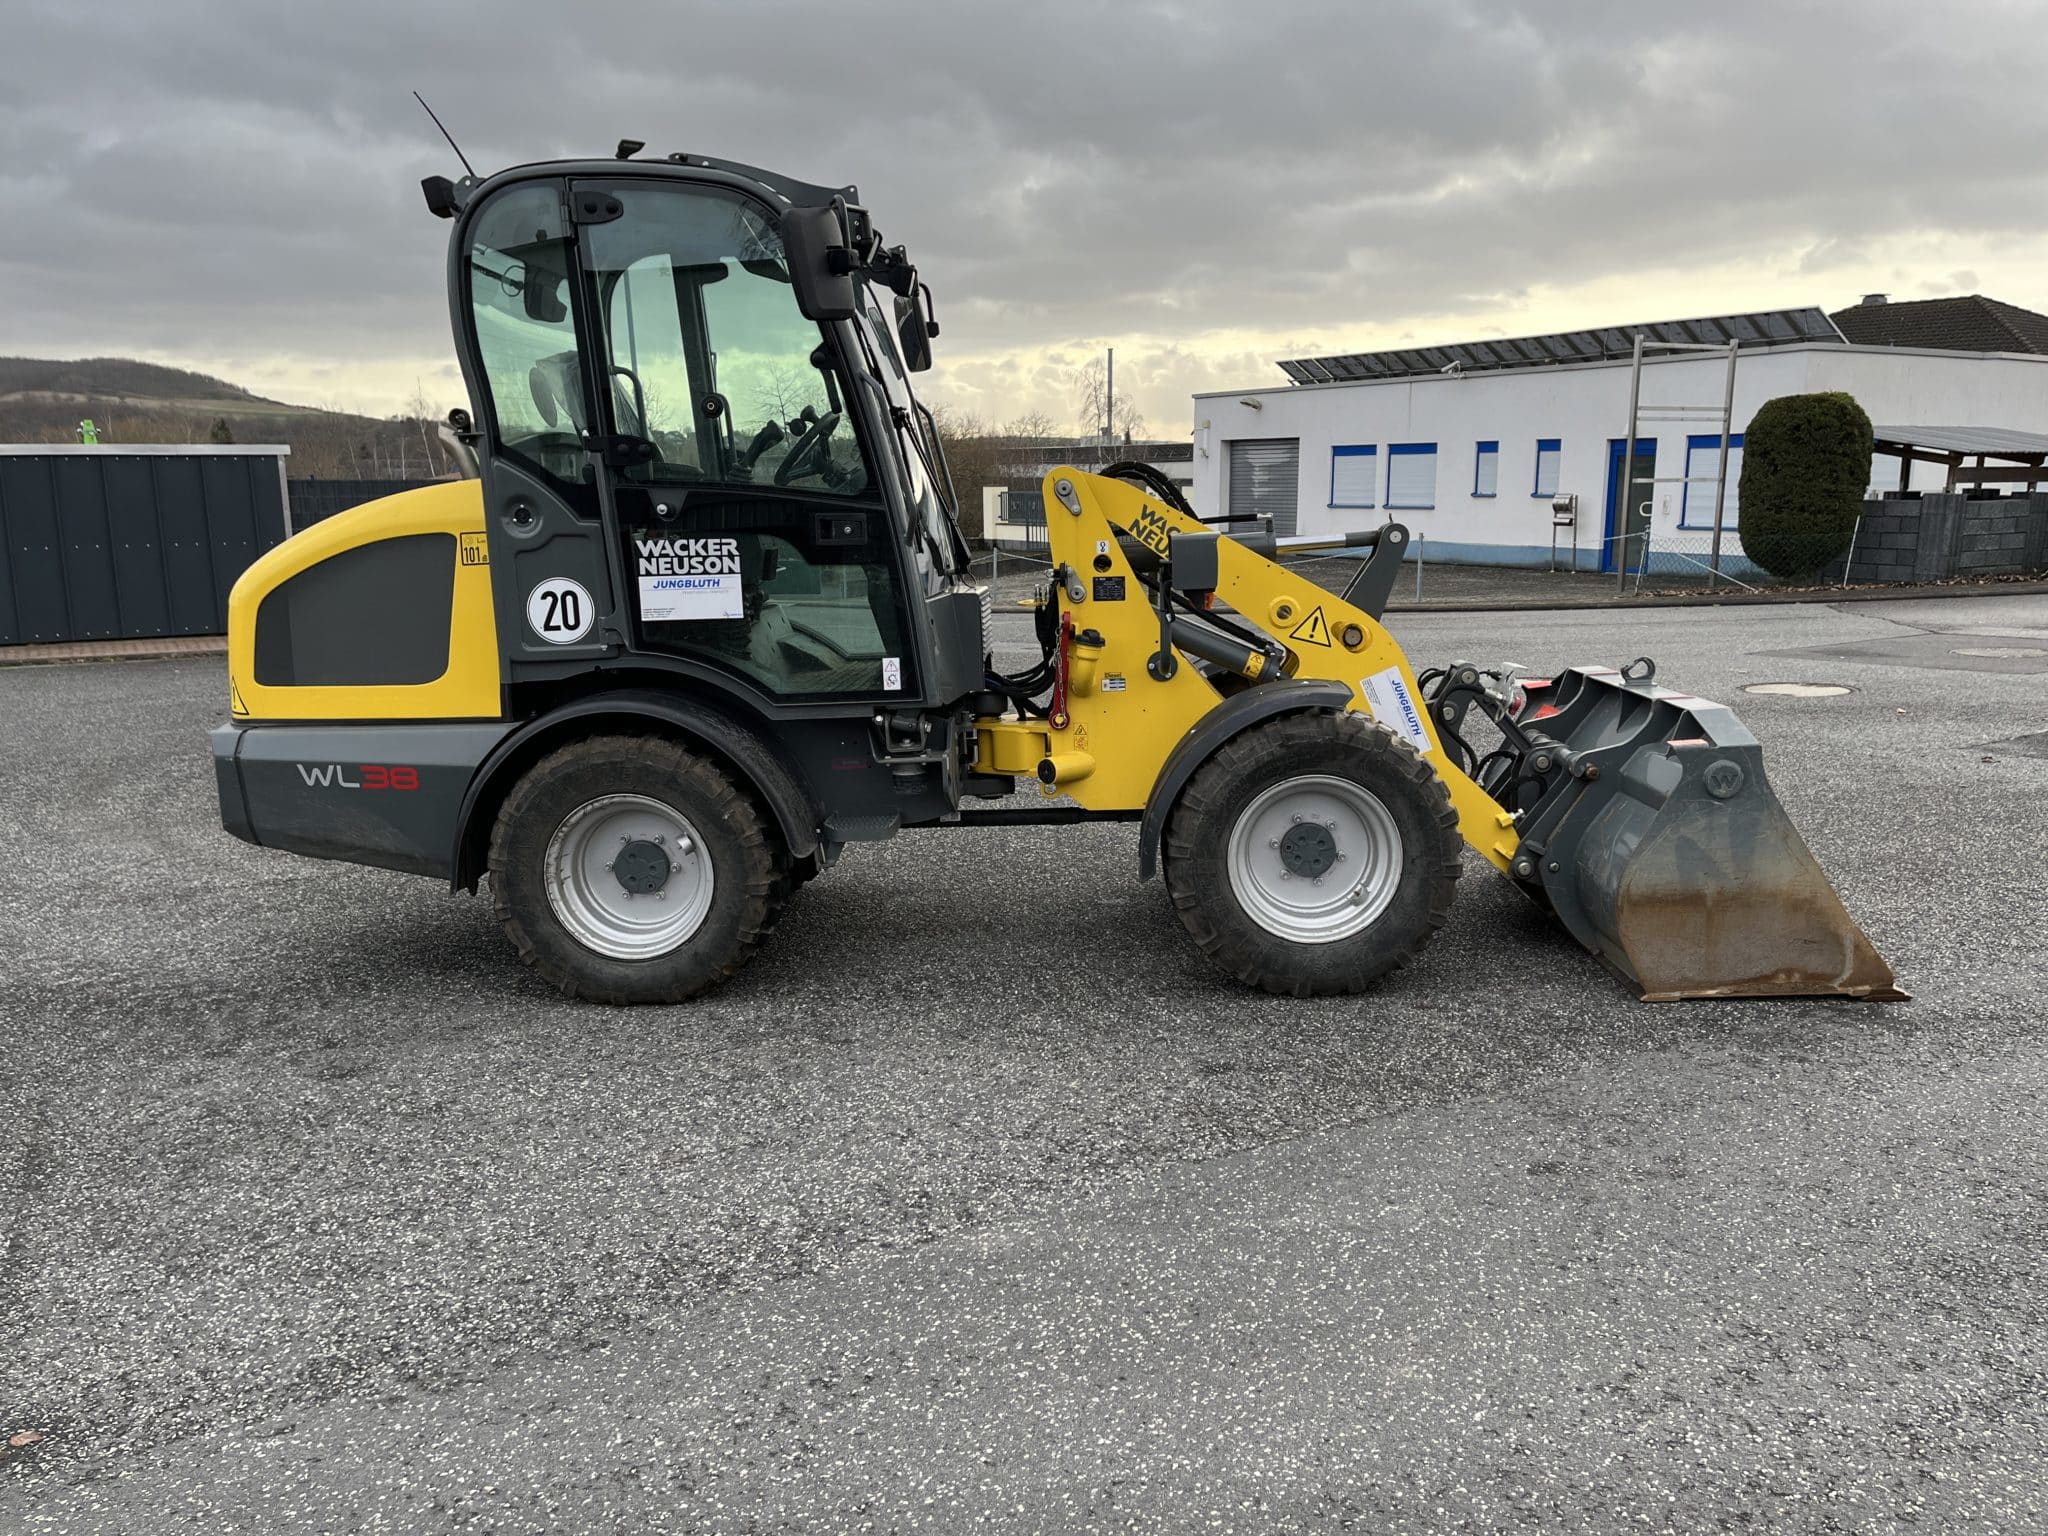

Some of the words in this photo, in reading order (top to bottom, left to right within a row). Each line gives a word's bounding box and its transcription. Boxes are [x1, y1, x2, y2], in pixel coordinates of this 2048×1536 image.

[464, 547, 480, 563] 101
[635, 538, 740, 557] WACKER
[639, 556, 742, 575] NEUSON
[653, 578, 721, 589] JUNGBLUTH
[540, 590, 582, 632] 20
[1391, 679, 1422, 736] JUNGBLUTH
[296, 763, 420, 791] WL38
